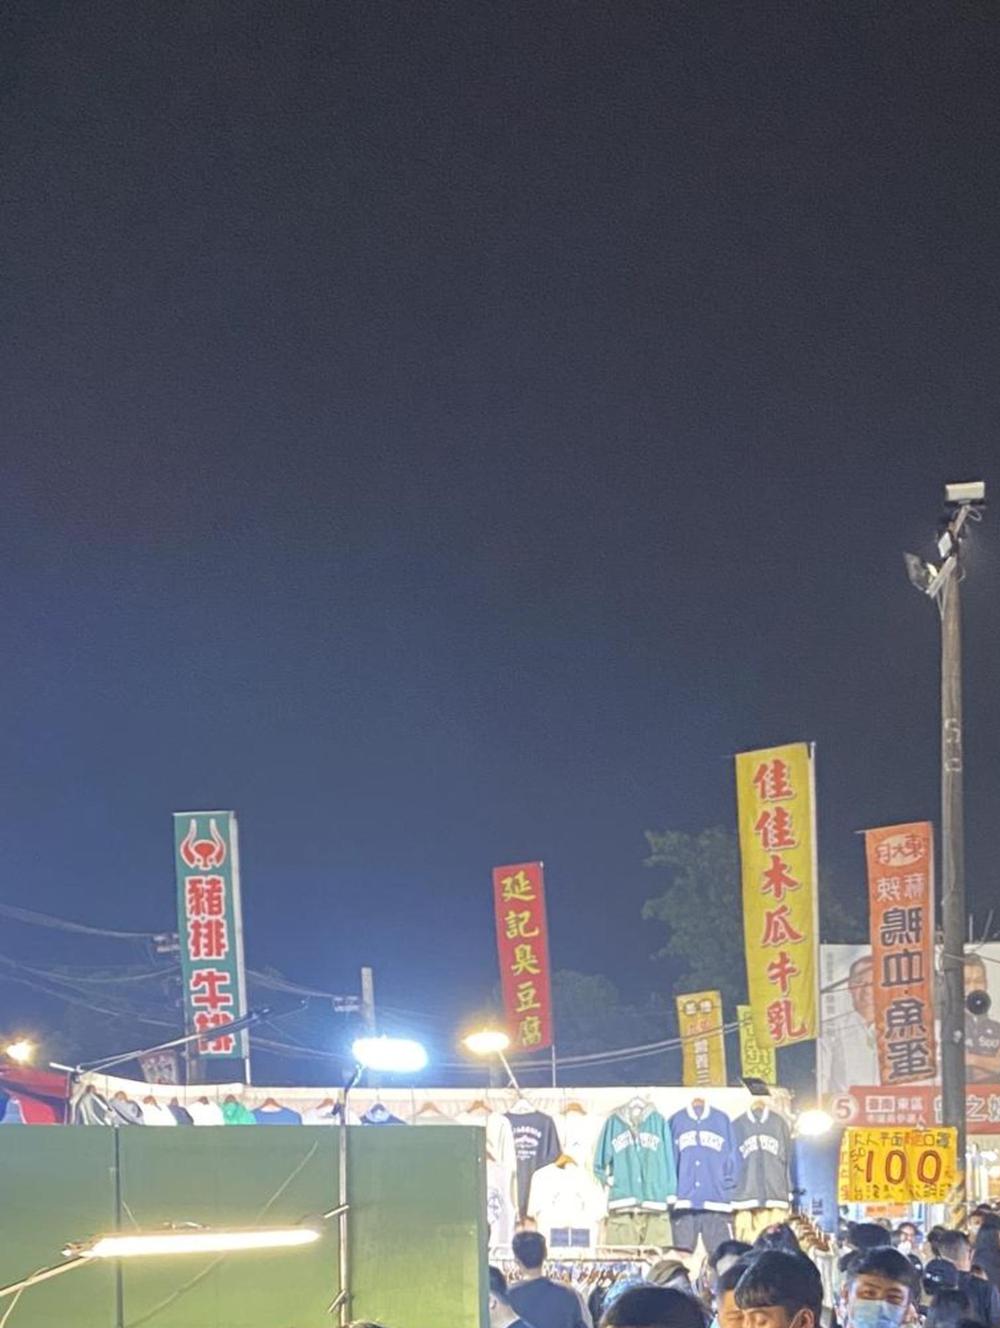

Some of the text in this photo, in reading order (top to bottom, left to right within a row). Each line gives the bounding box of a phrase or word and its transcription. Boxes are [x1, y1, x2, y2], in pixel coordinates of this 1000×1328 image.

[501, 870, 542, 1047] 延記臭豆腐
[752, 758, 807, 1042] 佳佳木瓜牛乳
[865, 1149, 942, 1185] 100
